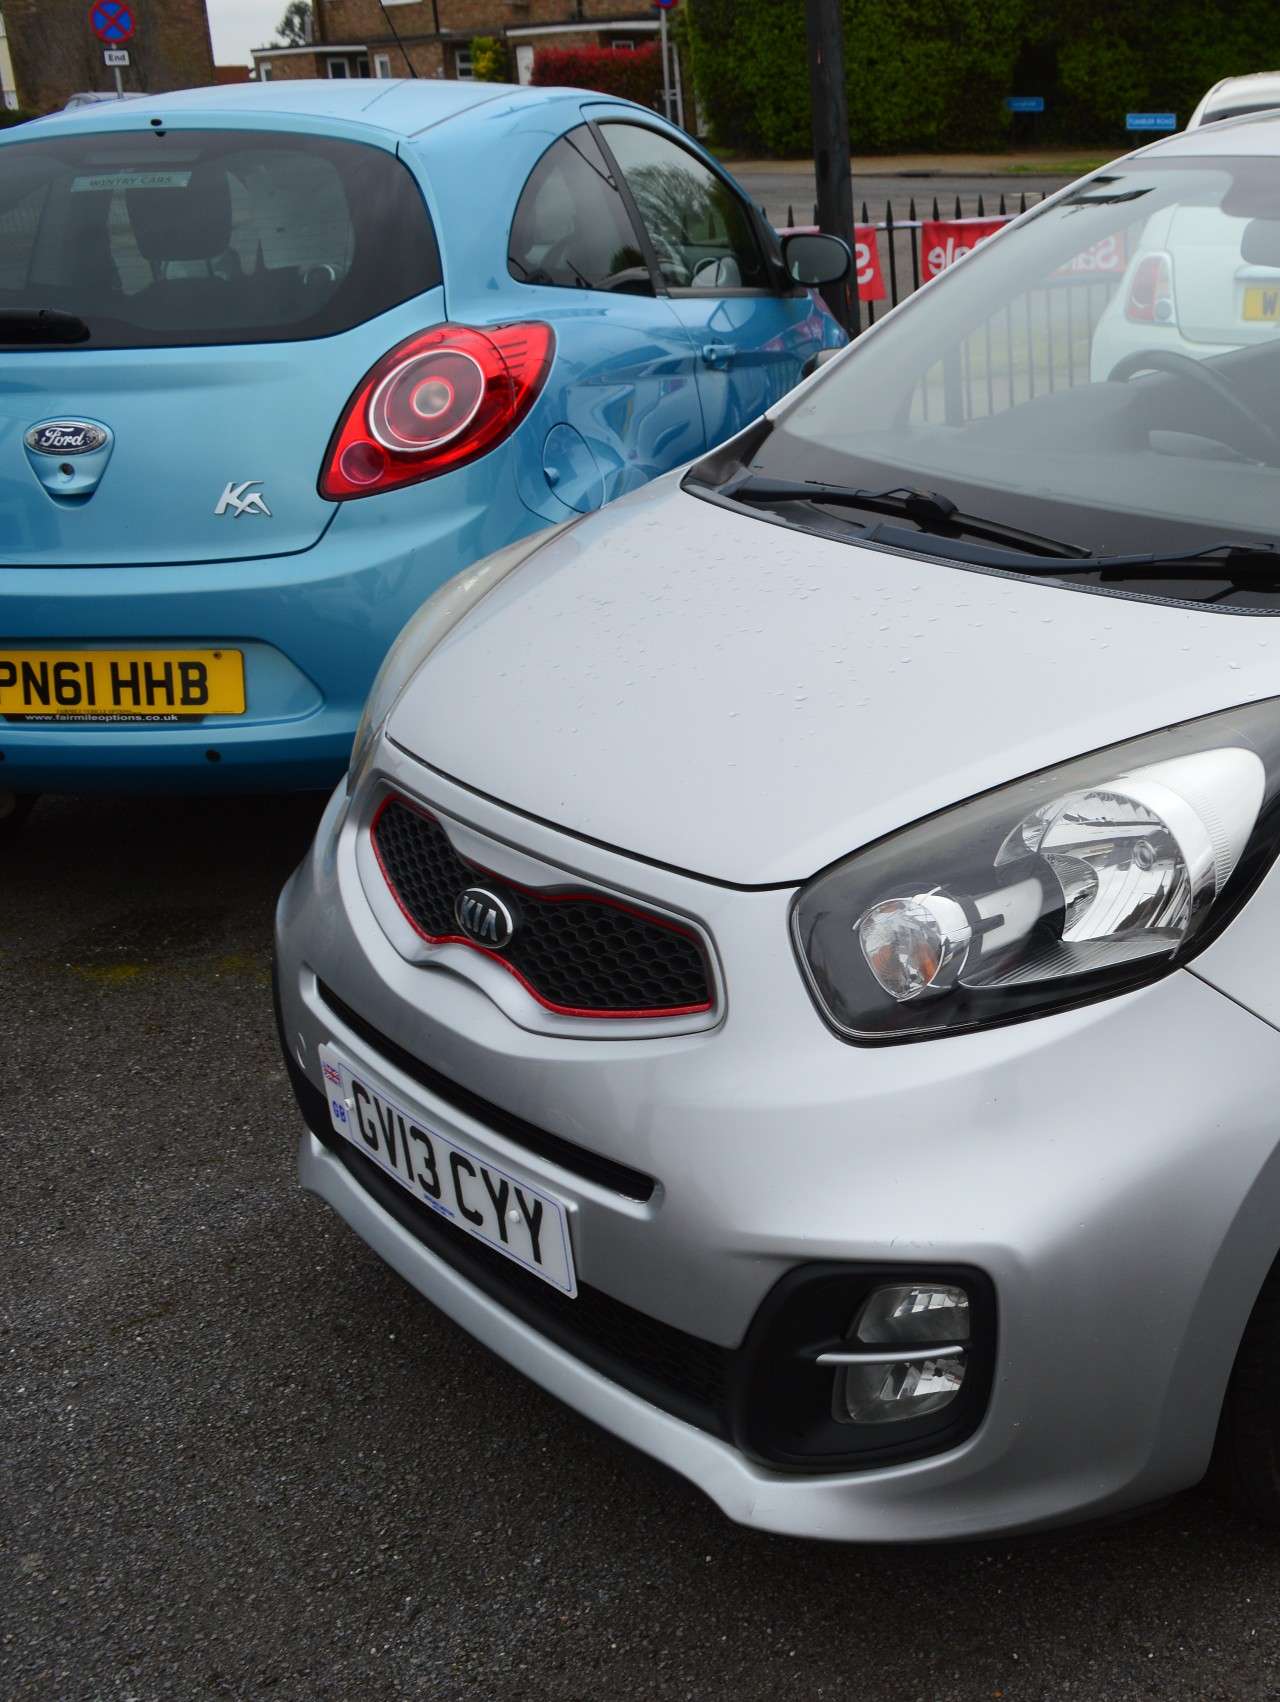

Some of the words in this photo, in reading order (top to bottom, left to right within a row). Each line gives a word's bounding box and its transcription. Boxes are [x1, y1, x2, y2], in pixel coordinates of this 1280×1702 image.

[41, 427, 86, 447] Ford
[110, 661, 209, 706] HHB
[25, 713, 179, 723] www.fairmileoptions.co.uk
[463, 895, 498, 943] KIA
[332, 1100, 348, 1124] GB
[351, 1079, 441, 1201] GV13
[449, 1151, 544, 1266] CYY
